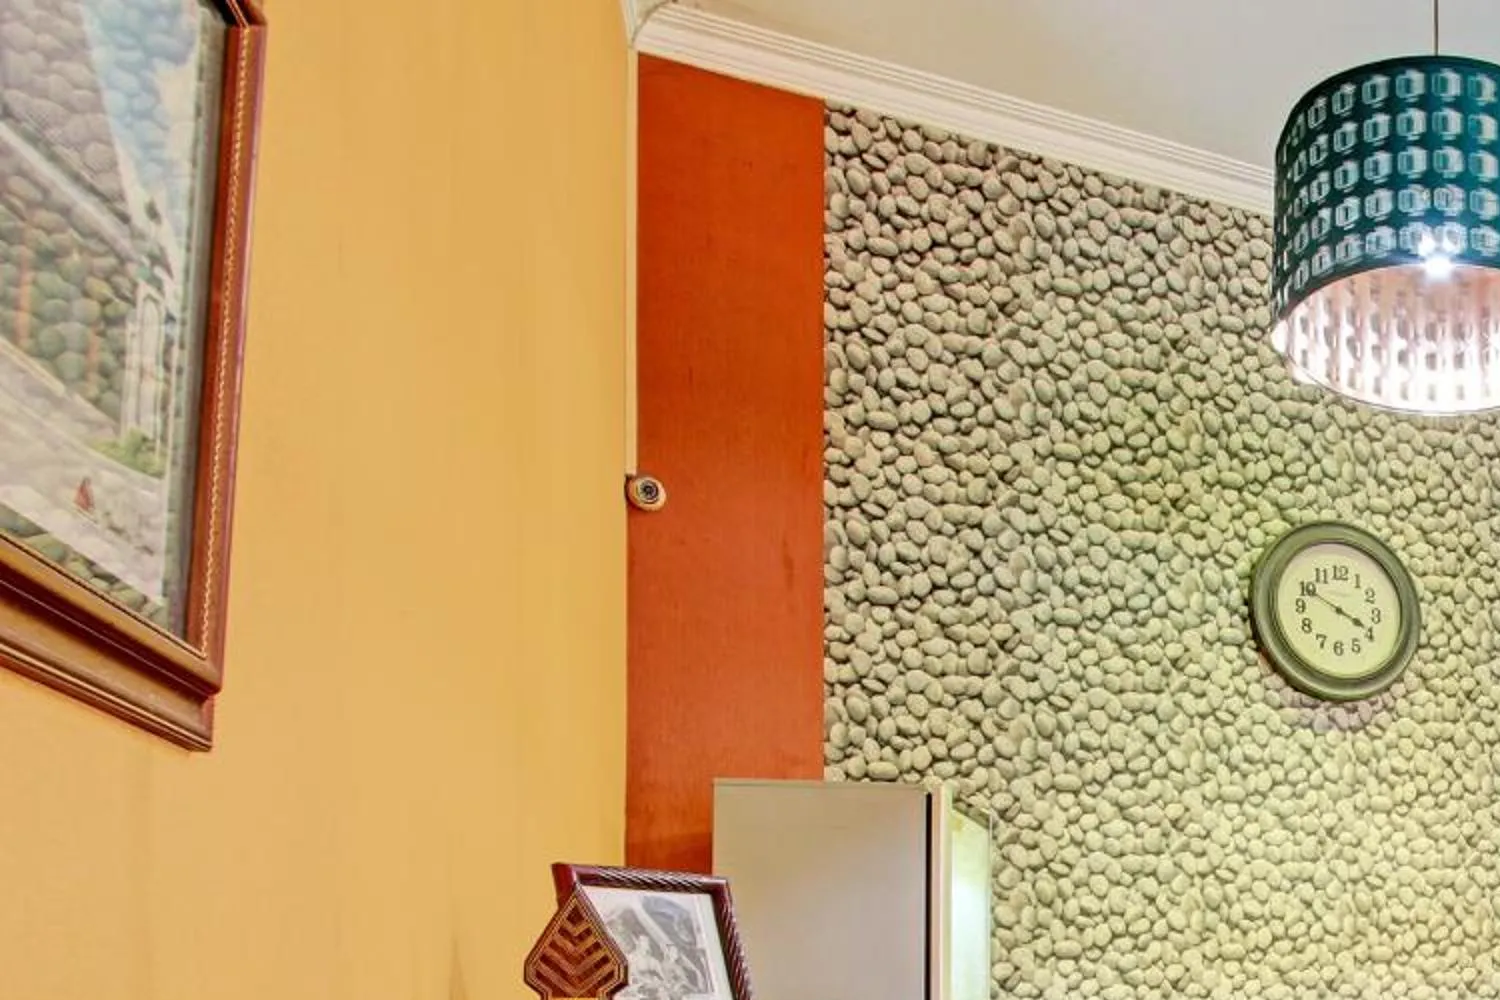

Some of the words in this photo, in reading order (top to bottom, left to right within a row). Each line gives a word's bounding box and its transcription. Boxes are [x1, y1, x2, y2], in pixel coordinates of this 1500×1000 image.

[1315, 568, 1328, 584] 11
[1332, 566, 1348, 581] 12
[1354, 574, 1361, 588] 1
[1300, 582, 1317, 596] 10
[1365, 588, 1375, 604] 2
[1296, 599, 1305, 613] 9
[1371, 608, 1381, 624] 3
[1302, 618, 1312, 633] 8
[1316, 634, 1327, 649] 7
[1364, 627, 1374, 642] 4
[1333, 641, 1344, 656] 6
[1352, 638, 1361, 653] 5
